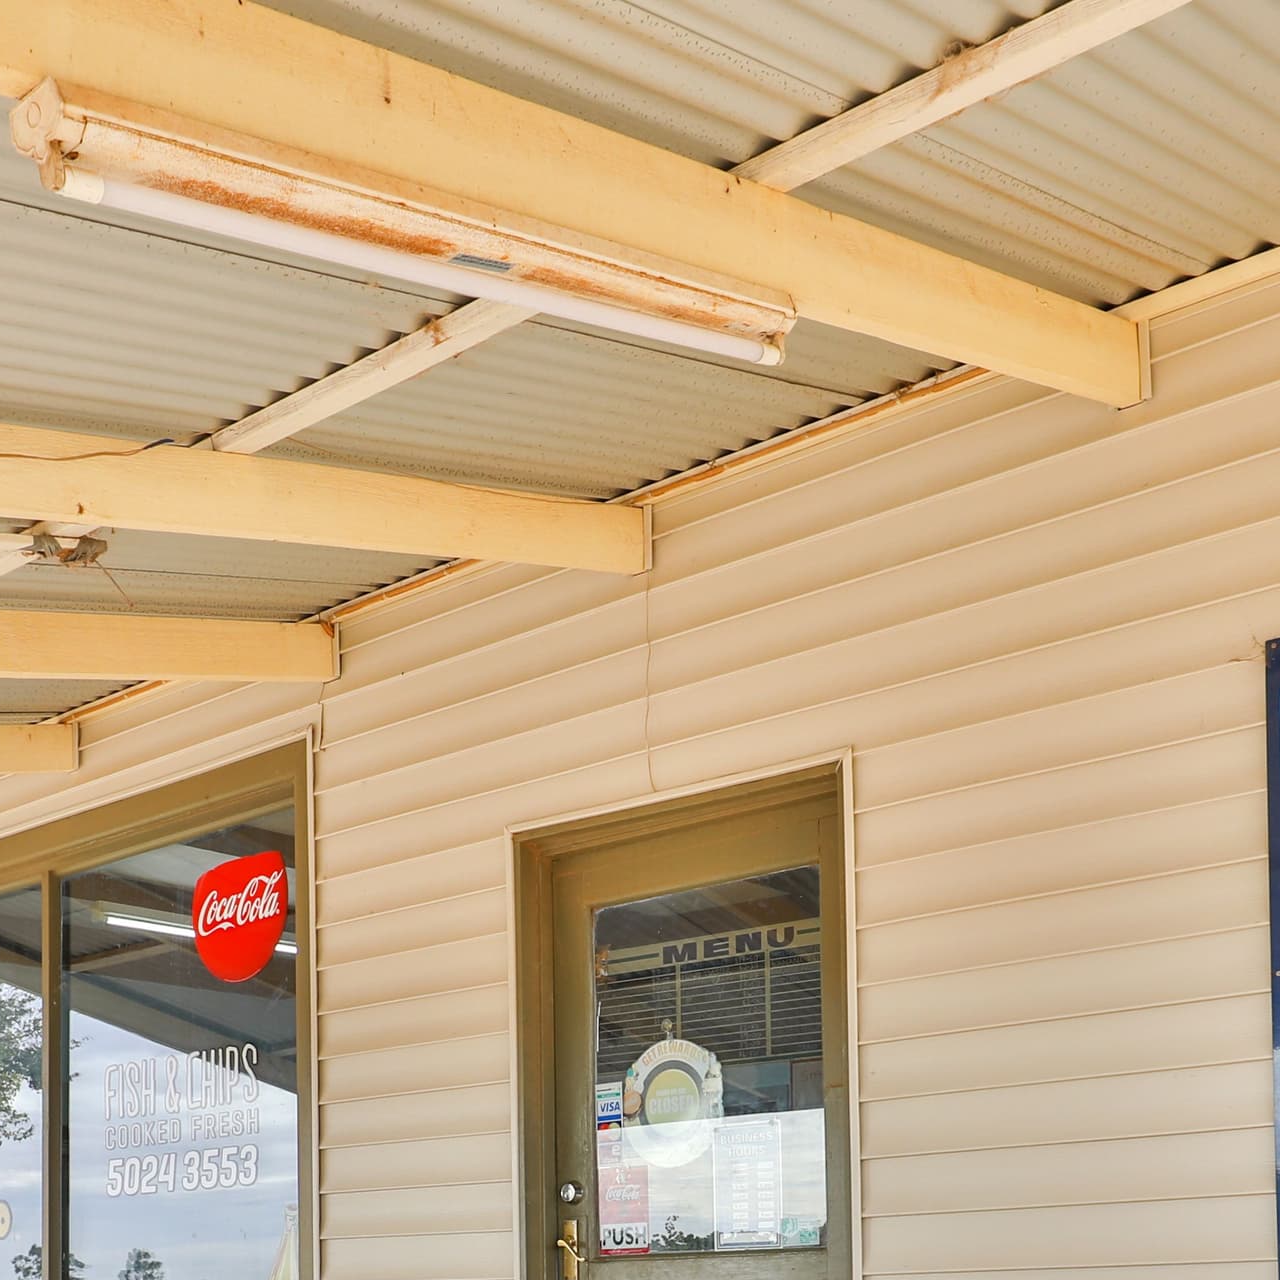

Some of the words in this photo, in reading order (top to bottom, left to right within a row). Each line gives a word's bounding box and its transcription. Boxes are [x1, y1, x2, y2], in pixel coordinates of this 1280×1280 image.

[662, 926, 795, 965] MENU
[104, 1057, 157, 1121] FISH
[165, 1054, 181, 1113] &
[185, 1043, 260, 1111] CHIPS
[600, 1101, 620, 1113] VISA
[104, 1118, 182, 1150] COOKED
[191, 1107, 260, 1141] FRESH
[105, 1152, 177, 1198] 5024
[181, 1144, 259, 1191] 3553
[602, 1225, 647, 1246] PUSH
